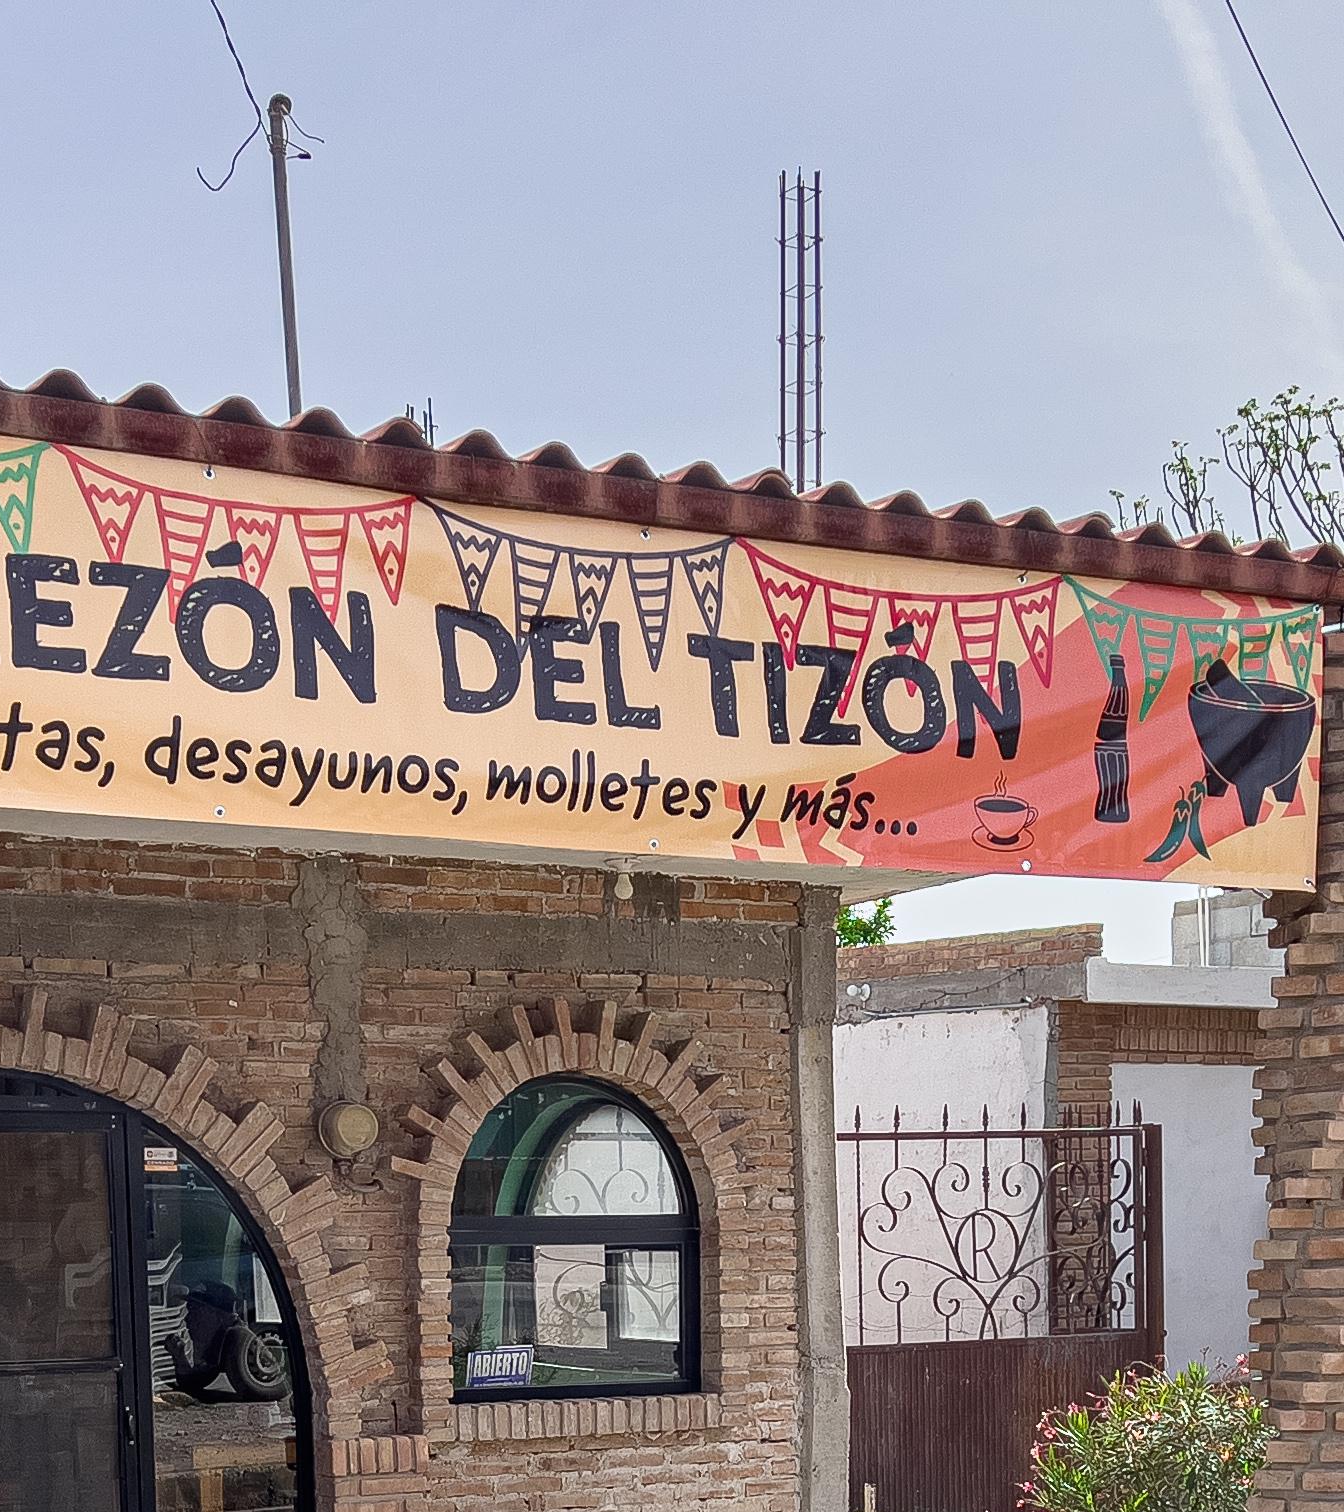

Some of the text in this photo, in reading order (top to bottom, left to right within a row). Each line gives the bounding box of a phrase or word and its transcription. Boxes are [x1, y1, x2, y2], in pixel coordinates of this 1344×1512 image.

[434, 604, 660, 730] DEL
[687, 622, 1022, 760] TIZÓN
[144, 715, 468, 816] desayunos,
[485, 749, 718, 821] molletes
[731, 783, 766, 840] y
[780, 772, 918, 836] más...
[473, 1351, 528, 1378] ABIERTO
